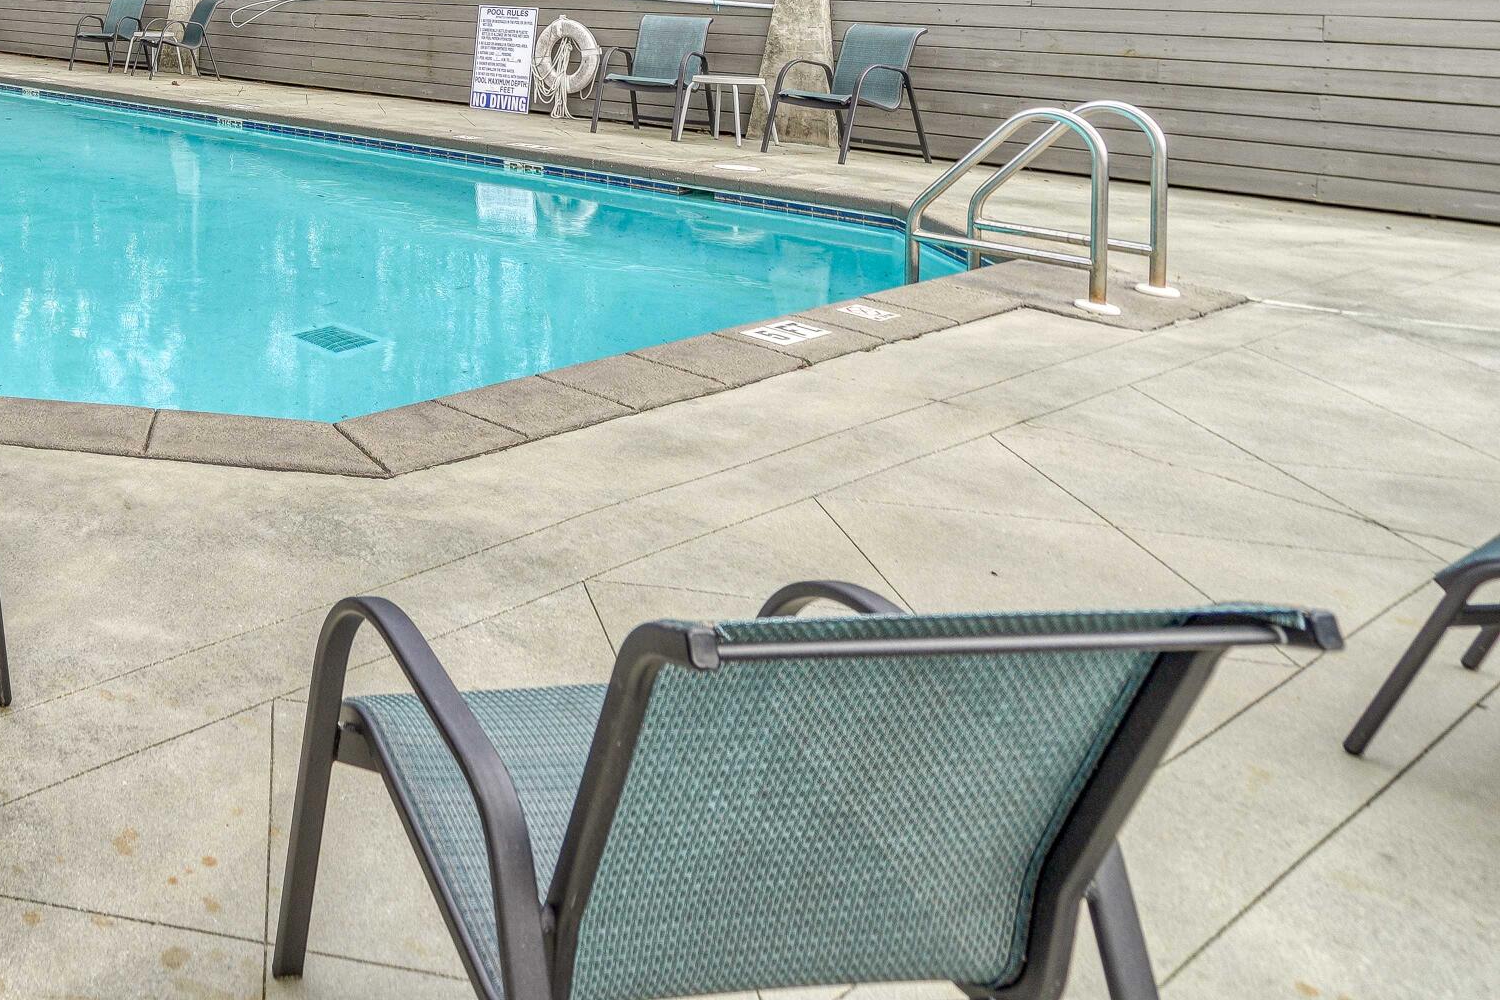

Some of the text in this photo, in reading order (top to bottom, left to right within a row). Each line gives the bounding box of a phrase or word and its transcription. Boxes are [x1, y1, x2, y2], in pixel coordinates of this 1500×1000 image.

[487, 8, 505, 16] POOL
[507, 9, 529, 17] RULES
[474, 76, 488, 84] POOL
[488, 78, 511, 86] MAXIMUM
[500, 86, 515, 94] FEET
[472, 92, 527, 112] NO DIVING
[774, 322, 822, 337] FT
